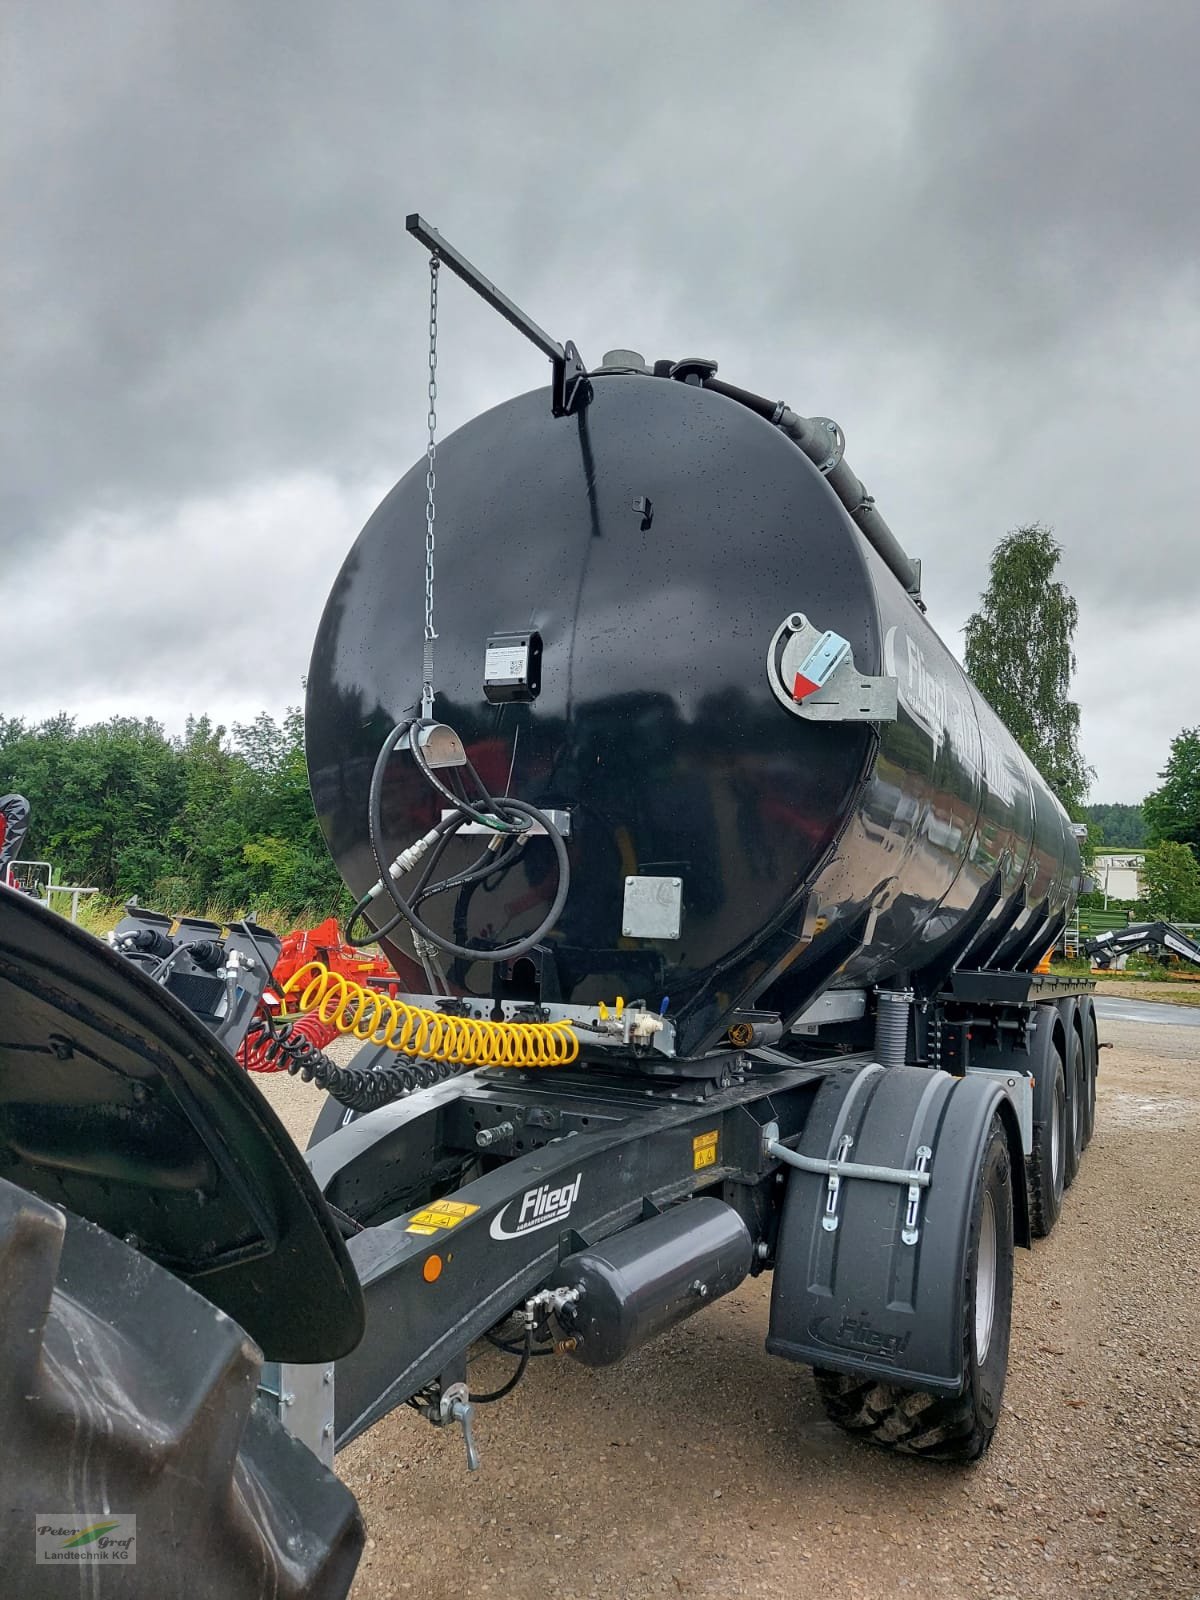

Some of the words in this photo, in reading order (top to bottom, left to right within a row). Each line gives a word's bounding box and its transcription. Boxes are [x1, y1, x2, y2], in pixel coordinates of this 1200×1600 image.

[906, 634, 947, 748] Fliegl
[518, 1172, 582, 1223] Fliegl
[836, 1316, 912, 1358] Fliegl
